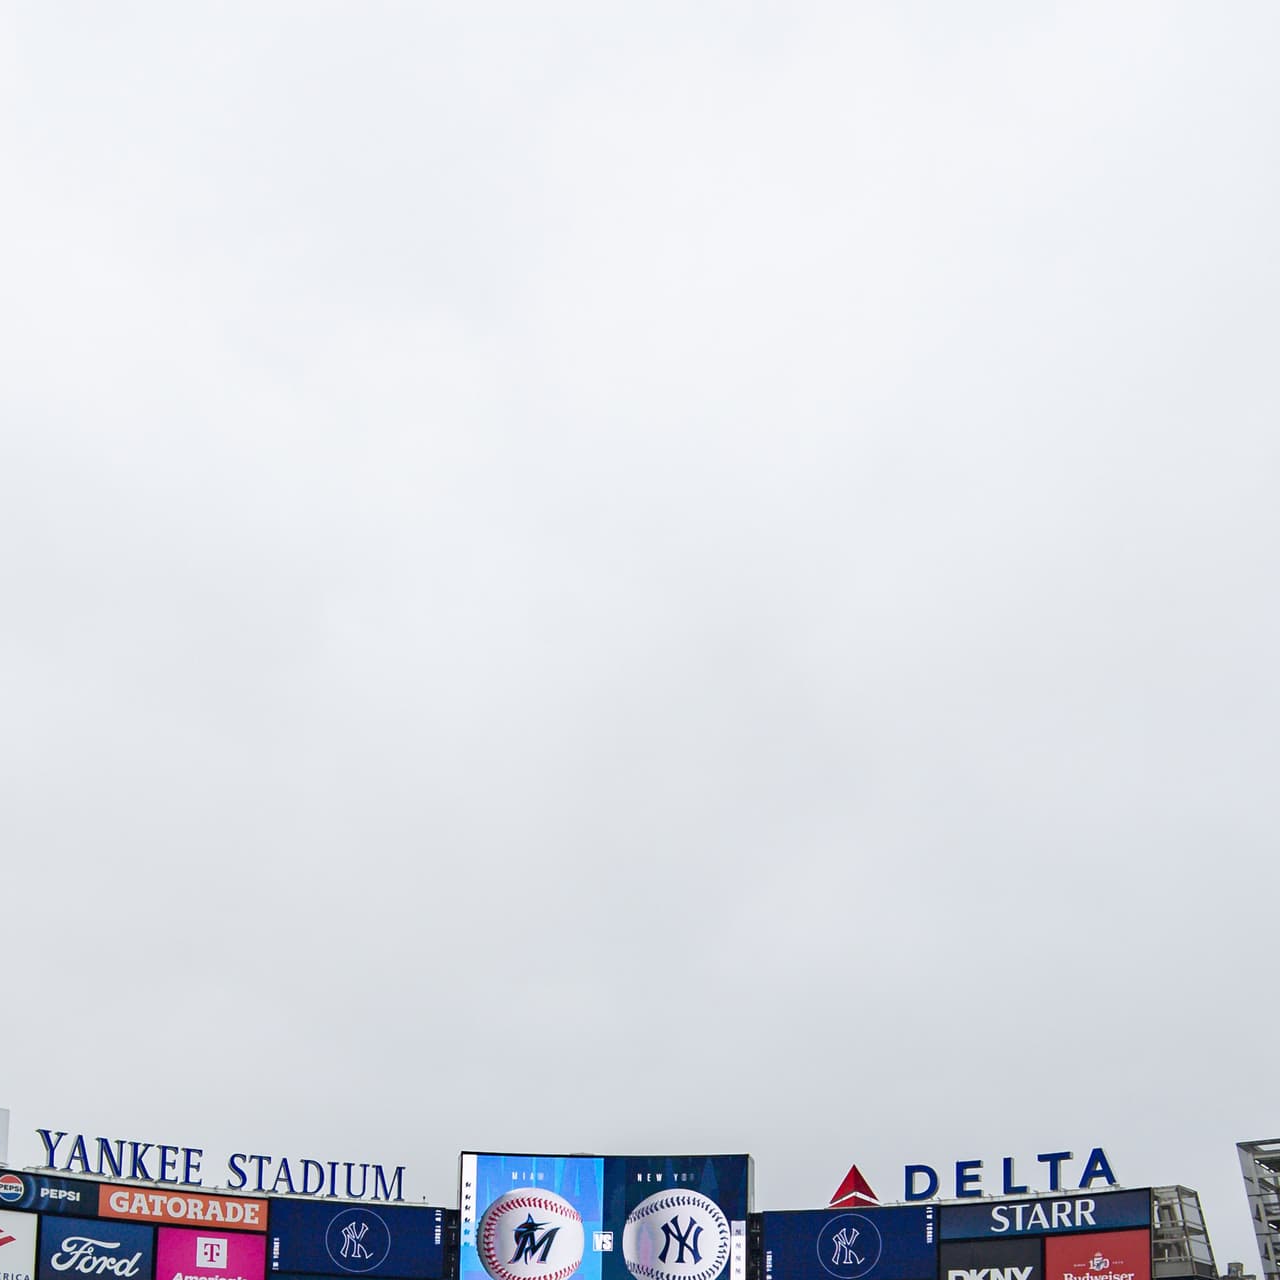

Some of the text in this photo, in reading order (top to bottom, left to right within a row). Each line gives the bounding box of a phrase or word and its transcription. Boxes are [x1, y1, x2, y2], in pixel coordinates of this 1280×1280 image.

[34, 1128, 407, 1201] YANKEE STADIUM
[637, 1173, 663, 1182] NEW
[904, 1147, 1119, 1202] DELTA
[40, 1187, 81, 1202] PEPSI
[109, 1191, 260, 1225] GATORADE
[990, 1199, 1097, 1233] STARR
[595, 1234, 612, 1250] VS
[658, 1214, 704, 1265] NY
[50, 1236, 143, 1278] Ford
